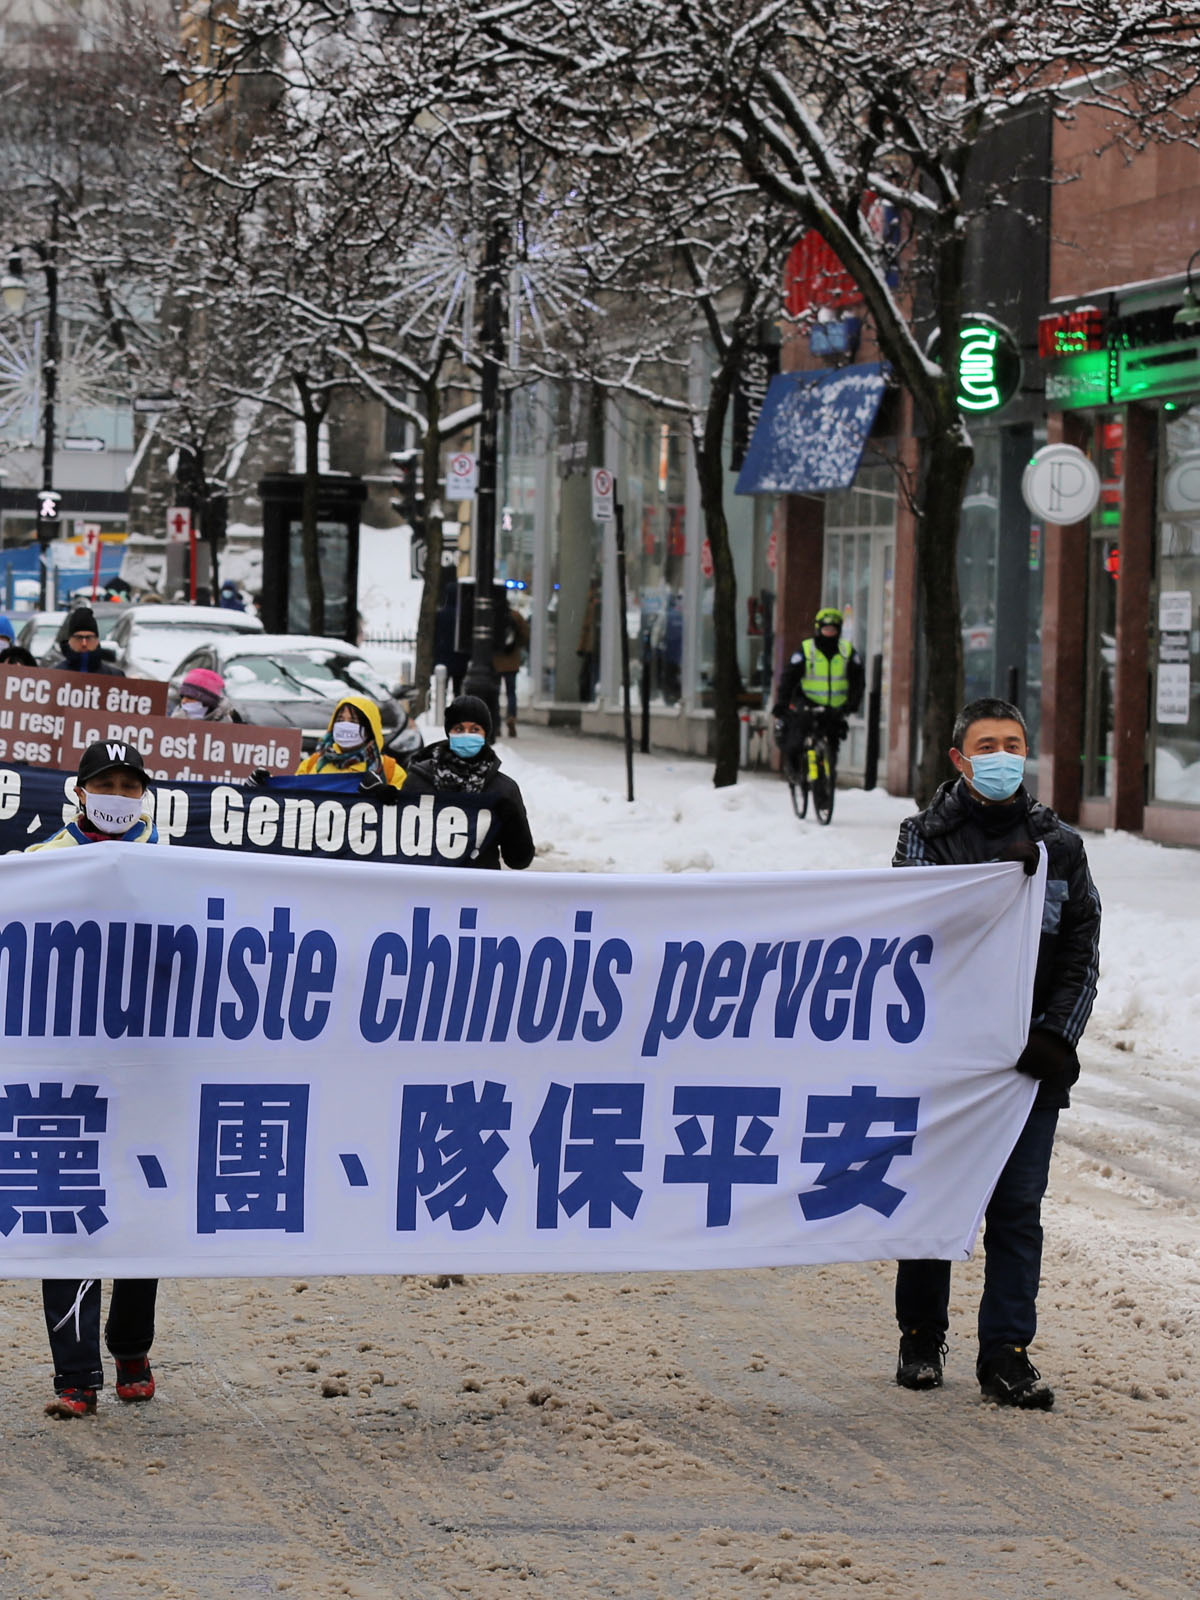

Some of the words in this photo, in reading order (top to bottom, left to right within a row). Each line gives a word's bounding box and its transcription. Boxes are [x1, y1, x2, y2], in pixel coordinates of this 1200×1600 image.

[5, 676, 51, 704] PCC
[56, 681, 100, 710] doit
[105, 688, 152, 716] être
[12, 740, 51, 764] ses
[72, 720, 100, 749] Le
[107, 724, 154, 756] PCC
[160, 732, 197, 760] est
[203, 733, 226, 763] la
[232, 739, 290, 769] vraie
[105, 743, 127, 761] W
[93, 808, 113, 823] END
[116, 813, 134, 824] CCP
[210, 785, 492, 860] Genocide!
[359, 906, 633, 1044] chinois
[641, 934, 934, 1057] pervers
